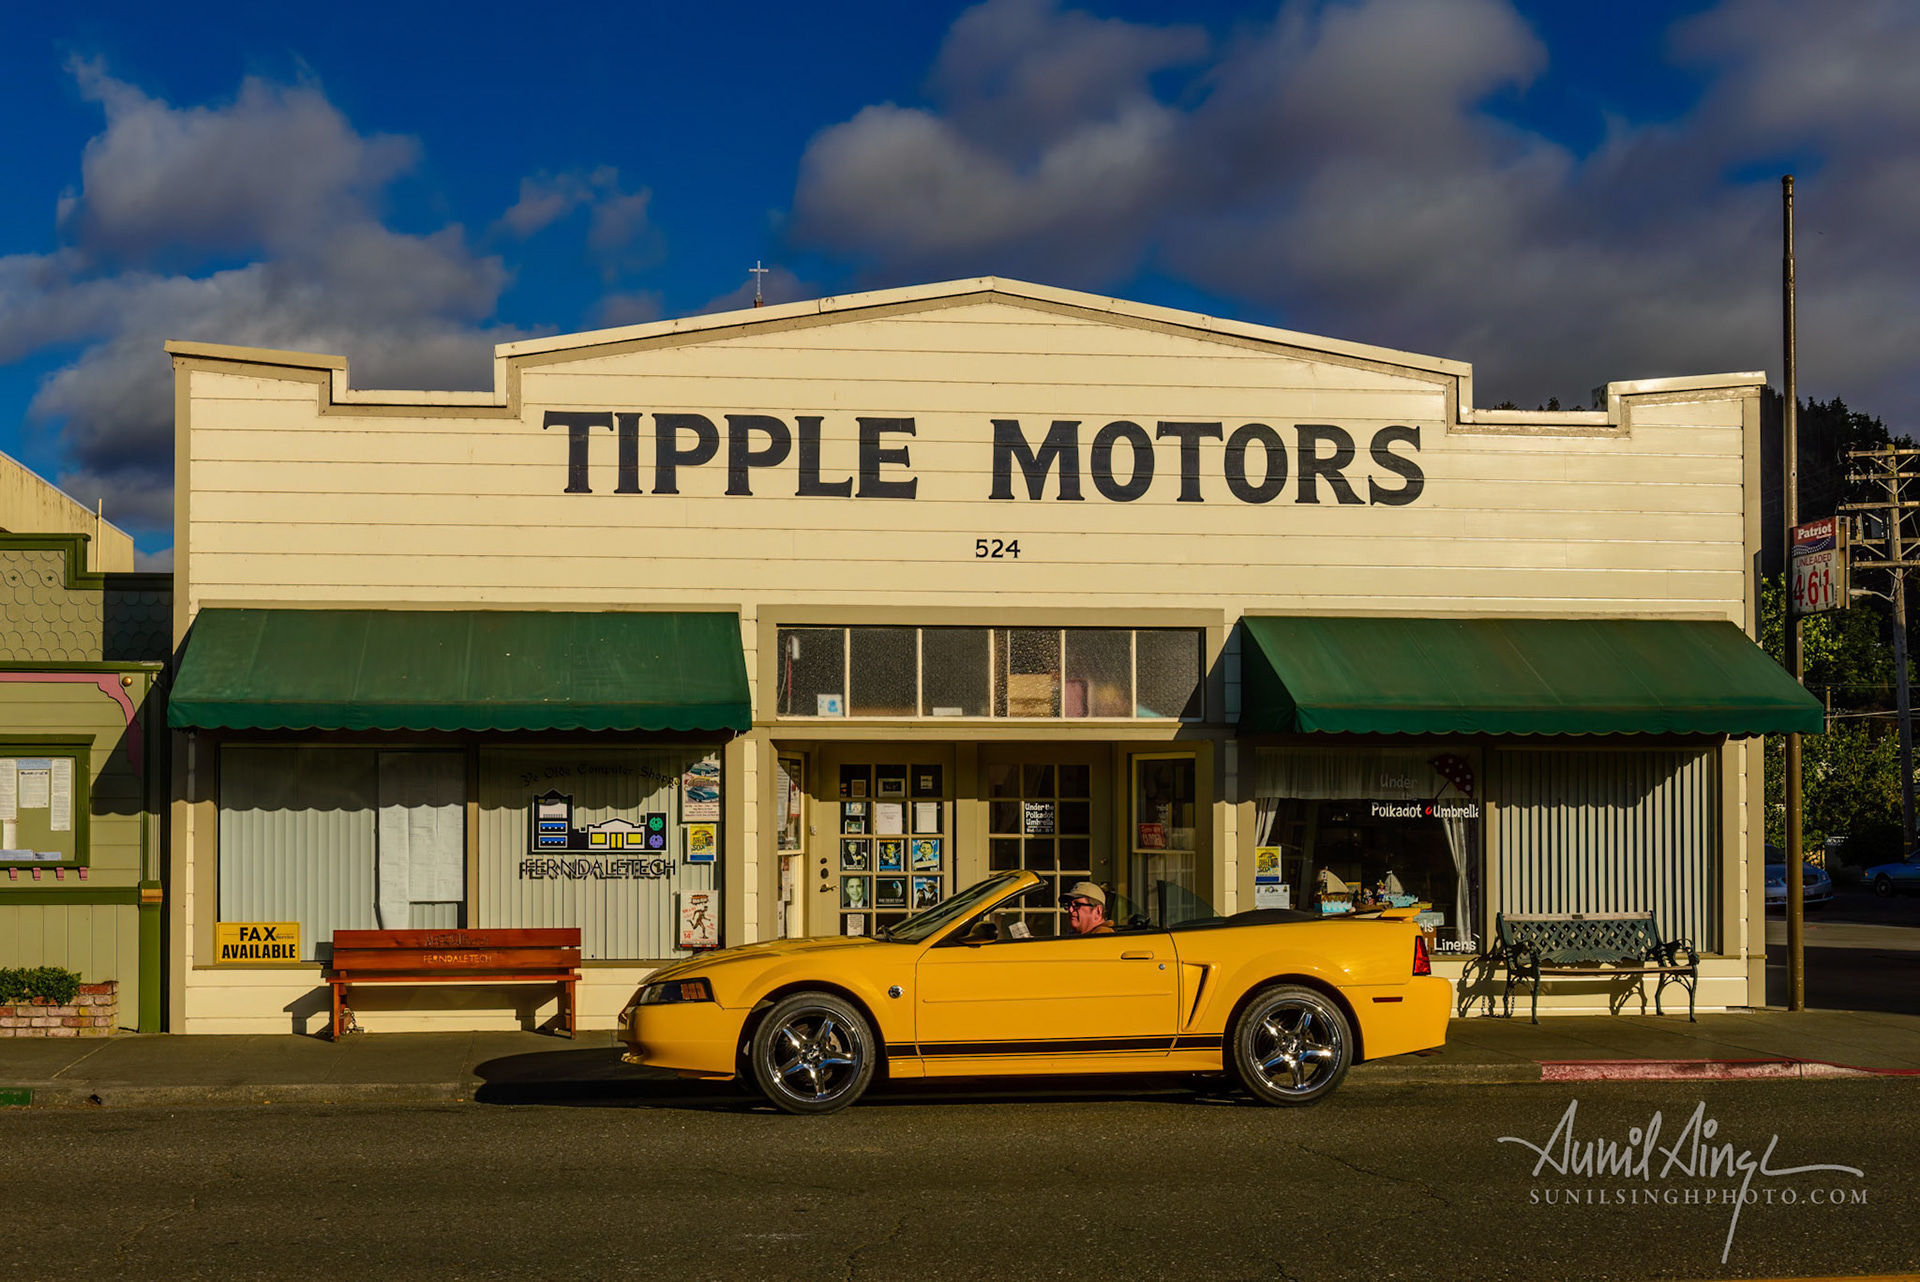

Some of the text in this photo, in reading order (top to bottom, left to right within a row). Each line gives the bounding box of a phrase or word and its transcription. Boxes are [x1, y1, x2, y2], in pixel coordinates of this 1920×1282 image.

[543, 411, 1425, 505] TIPPLE MOTORS
[1797, 523, 1832, 541] Patriot
[975, 538, 1021, 559] 524
[1796, 553, 1832, 568] UNLEADED
[521, 772, 539, 787] Ye
[544, 766, 571, 779] Olde
[577, 763, 635, 777] Computer
[640, 766, 681, 790] Shoppe
[1380, 774, 1418, 789] Under
[1401, 791, 1418, 801] the
[1025, 802, 1045, 811] Under
[1371, 802, 1422, 818] Polkadot
[1025, 811, 1054, 819] Polkadot
[1026, 818, 1054, 826] Umbrella
[239, 926, 277, 941] FAX
[221, 944, 296, 959] AVAILABLE
[1434, 938, 1477, 951] Linens
